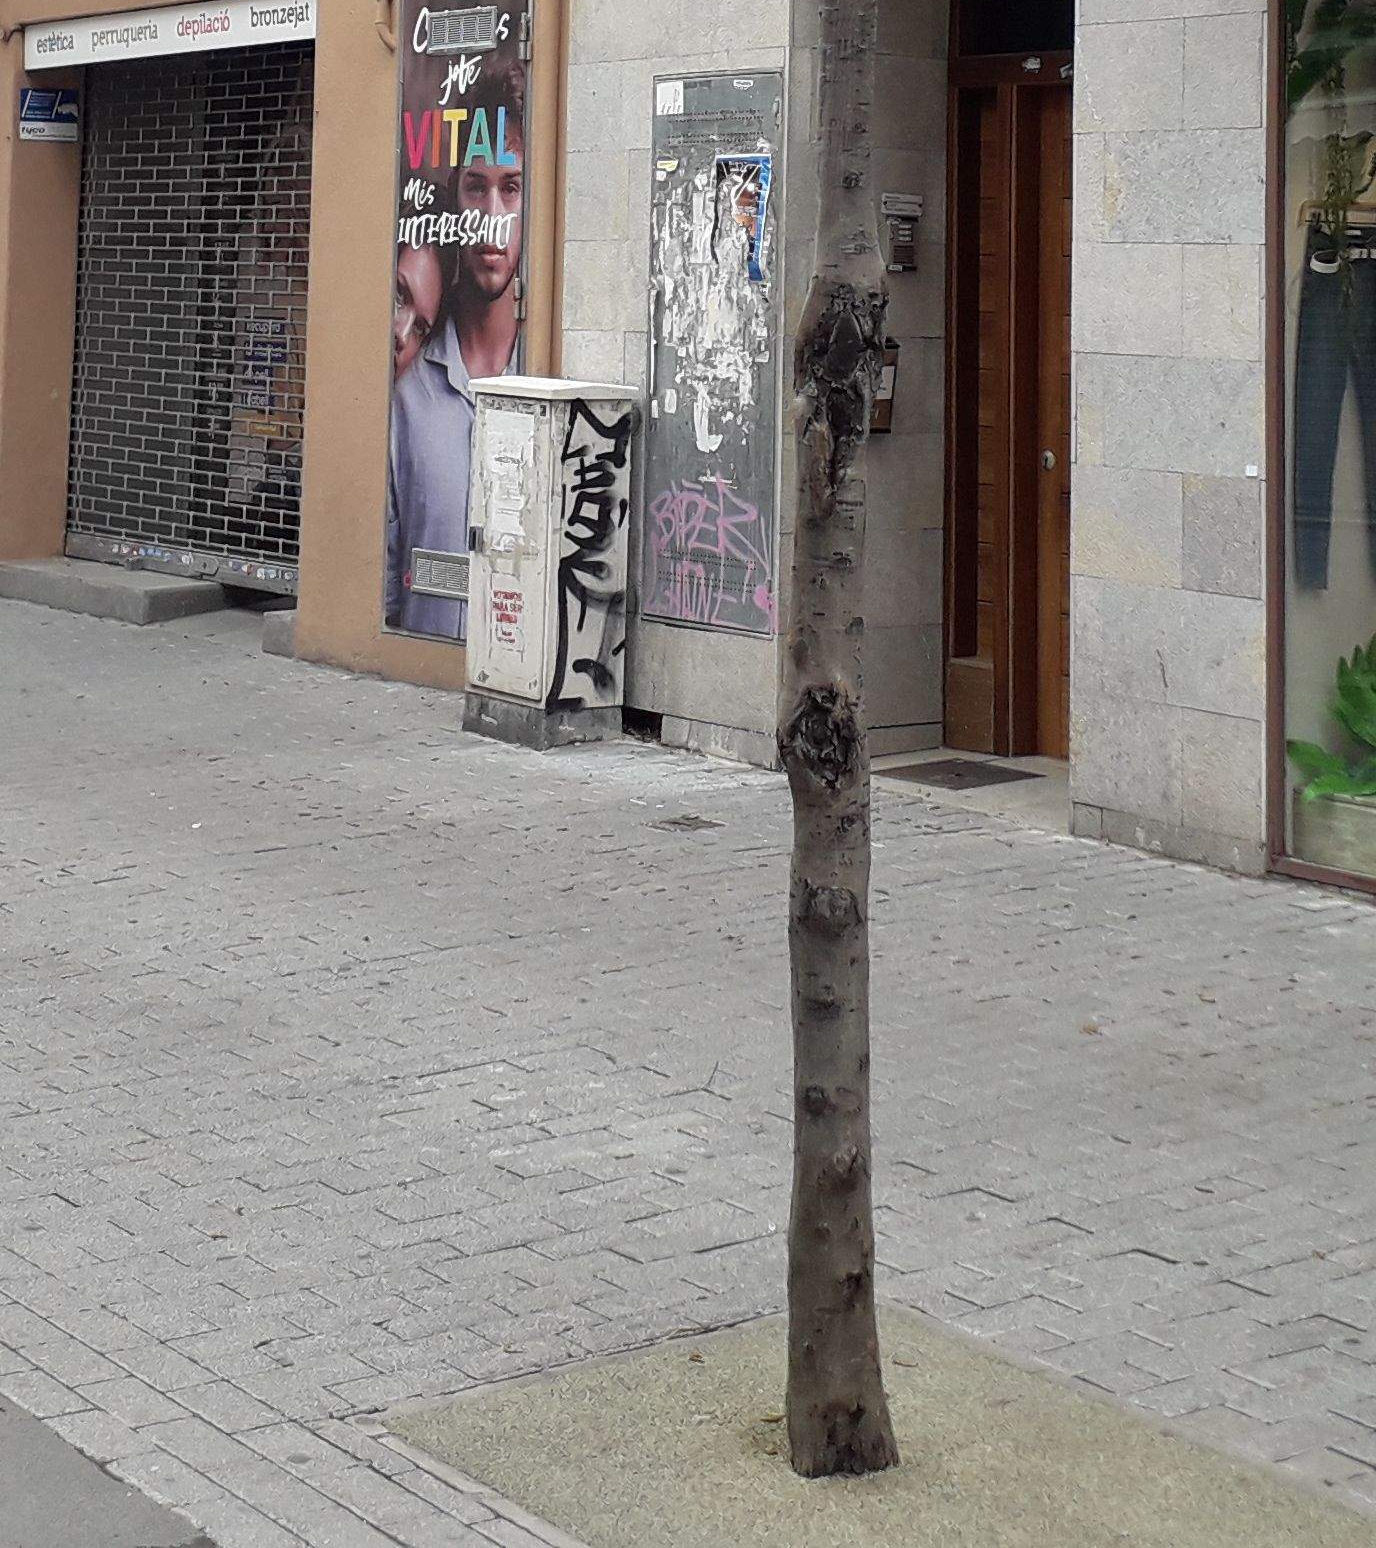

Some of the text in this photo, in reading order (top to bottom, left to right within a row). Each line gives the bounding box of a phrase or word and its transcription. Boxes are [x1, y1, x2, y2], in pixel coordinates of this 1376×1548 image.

[91, 19, 158, 52] perruqueria
[176, 8, 230, 41] depilació
[250, 1, 310, 29] bronzejat
[403, 106, 517, 169] VITAL
[397, 208, 518, 249] INTERESSANT
